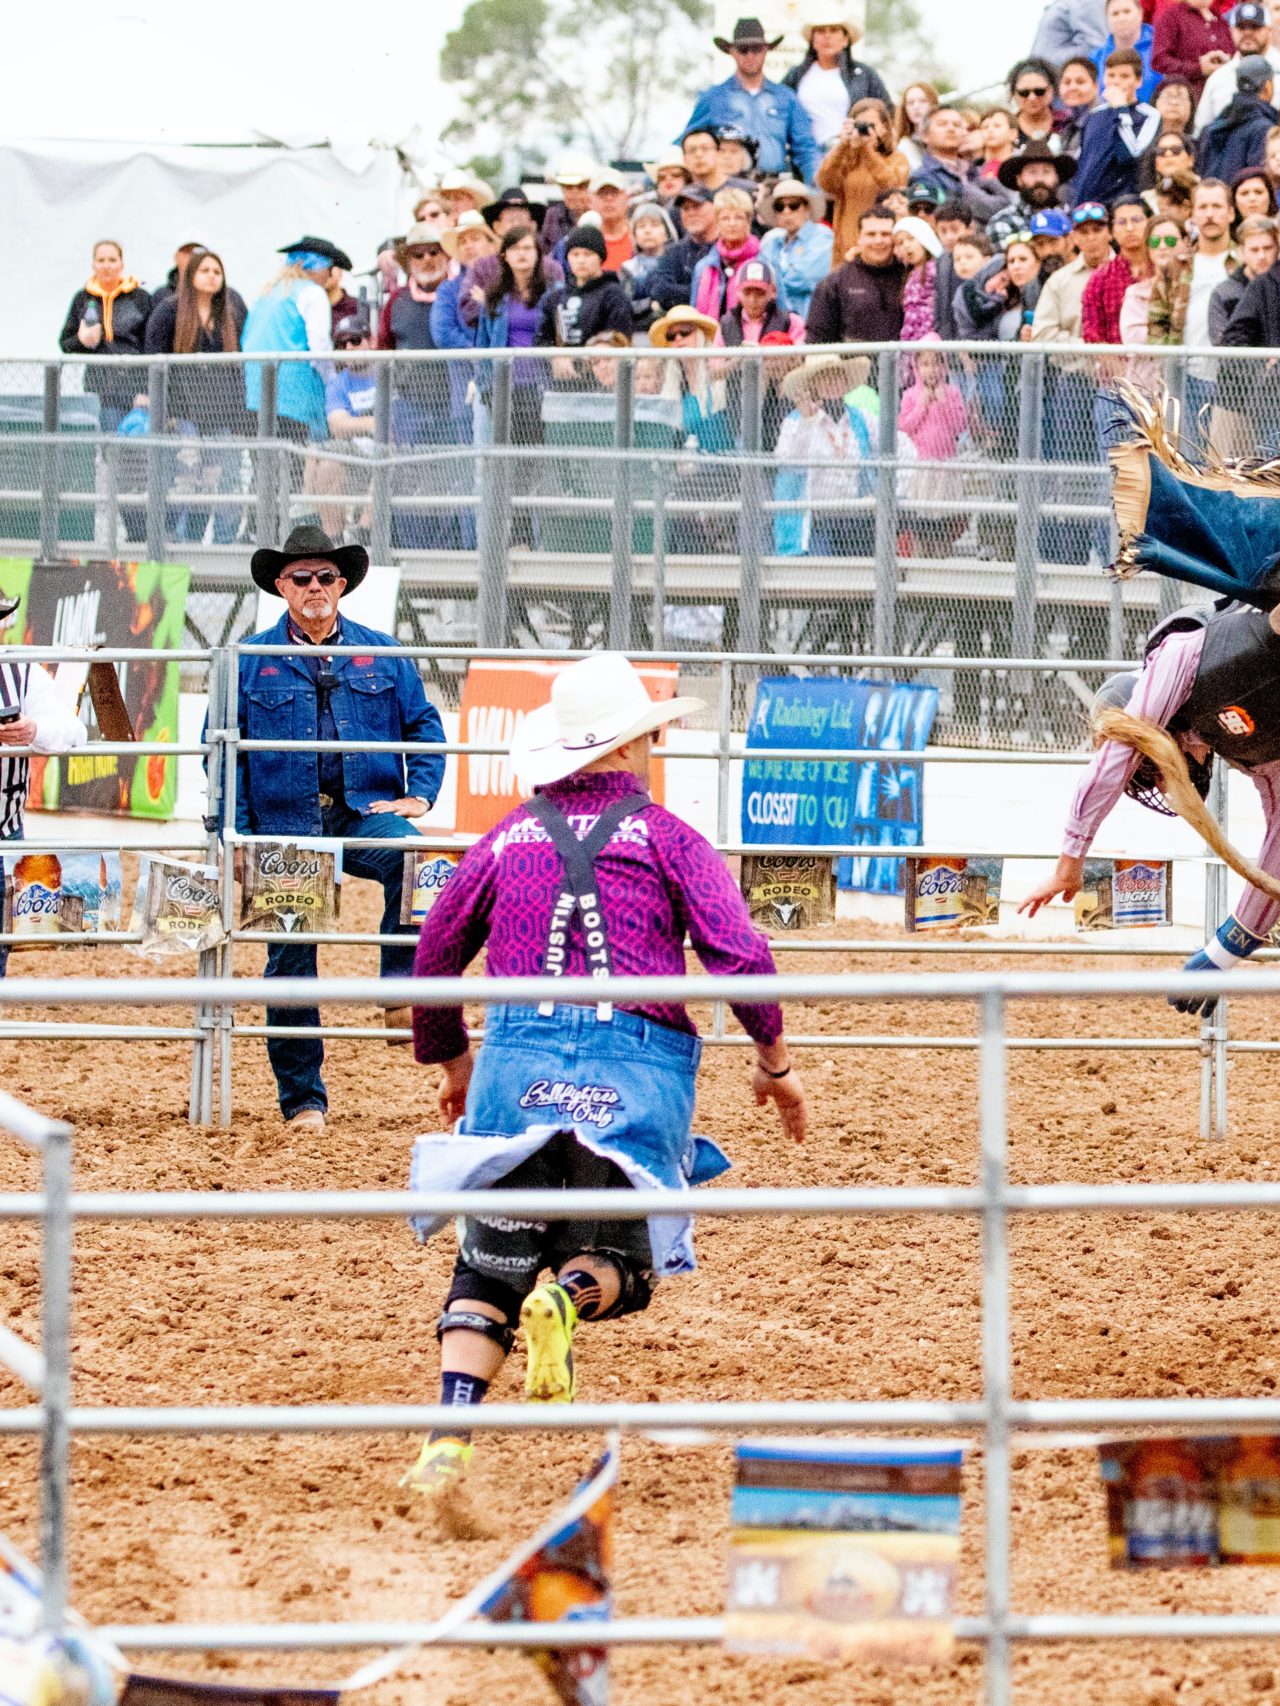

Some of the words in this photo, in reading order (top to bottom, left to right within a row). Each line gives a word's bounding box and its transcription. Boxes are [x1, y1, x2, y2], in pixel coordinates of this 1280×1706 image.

[772, 697, 827, 737] Radiology
[747, 791, 798, 825] CLOSEST
[799, 794, 817, 826] TO
[260, 851, 320, 876] Coors
[757, 855, 816, 870] Coors
[418, 865, 449, 890] Coo
[918, 874, 965, 897] Coors
[1116, 875, 1161, 893] Coors
[16, 891, 59, 914] Coors
[166, 875, 220, 907] Coors
[265, 894, 314, 906] RODEO
[762, 885, 811, 897] RODEO
[1119, 891, 1159, 904] LIGHT
[168, 920, 202, 931] ROD
[546, 892, 577, 977] JUSTIN
[579, 893, 610, 980] BOOTS
[572, 1103, 614, 1128] Only
